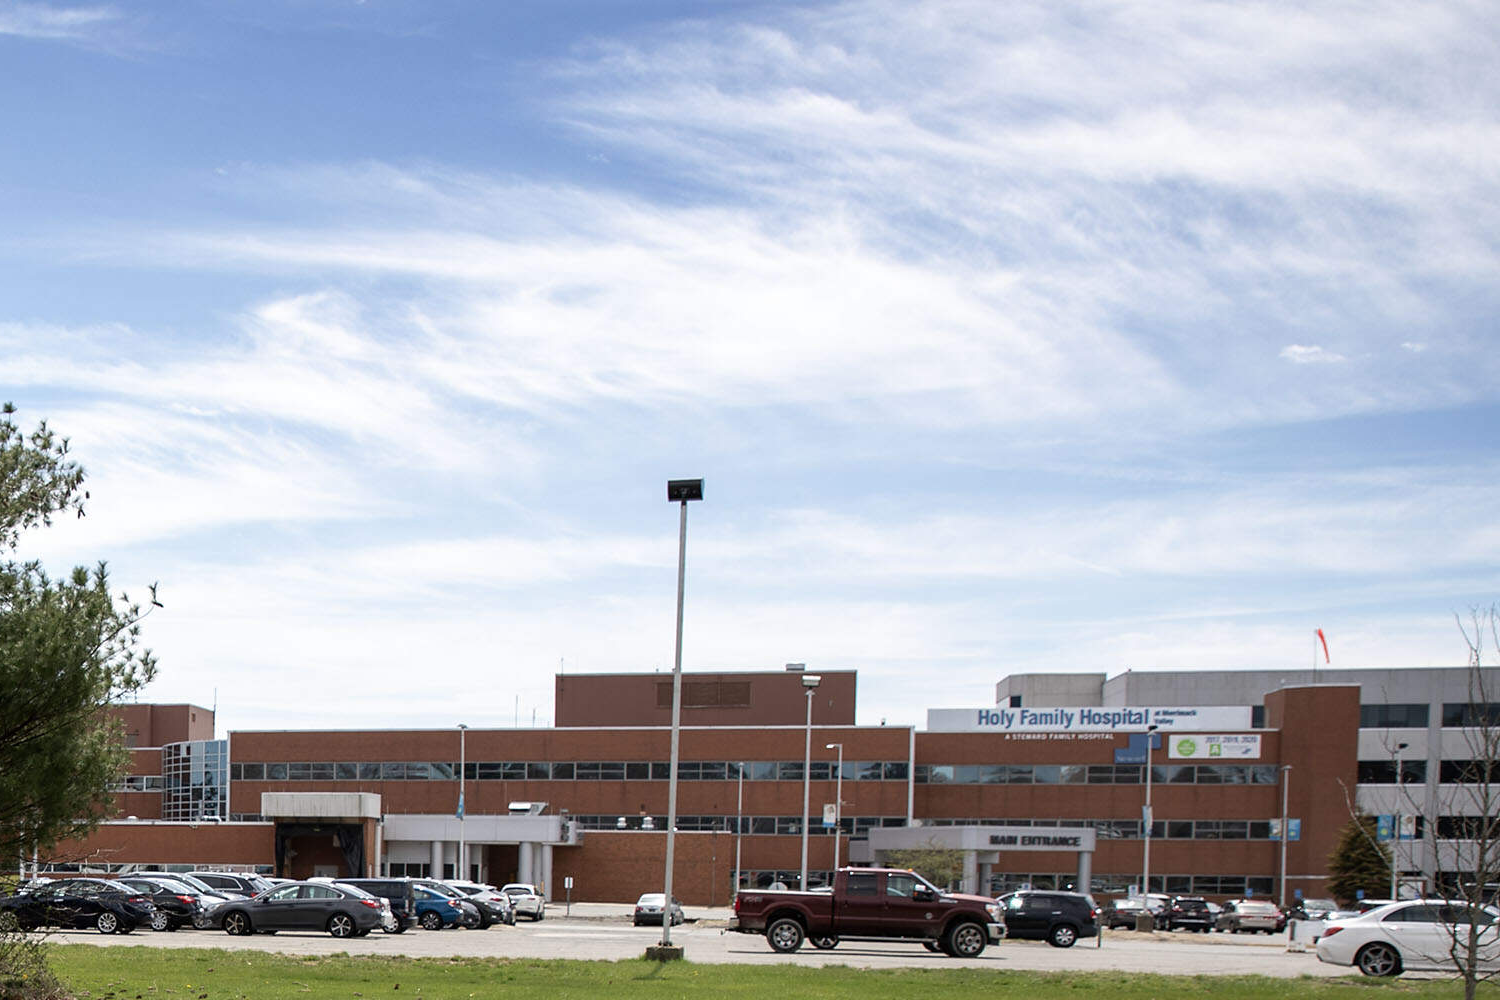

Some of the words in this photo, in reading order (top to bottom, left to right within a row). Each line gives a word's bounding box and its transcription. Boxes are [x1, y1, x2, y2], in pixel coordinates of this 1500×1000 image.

[978, 709, 1015, 729] Holy
[1020, 708, 1074, 729] Family
[1080, 708, 1149, 728] Hospital
[989, 835, 1018, 846] MAIN
[1021, 836, 1082, 847] ENTRANCE
